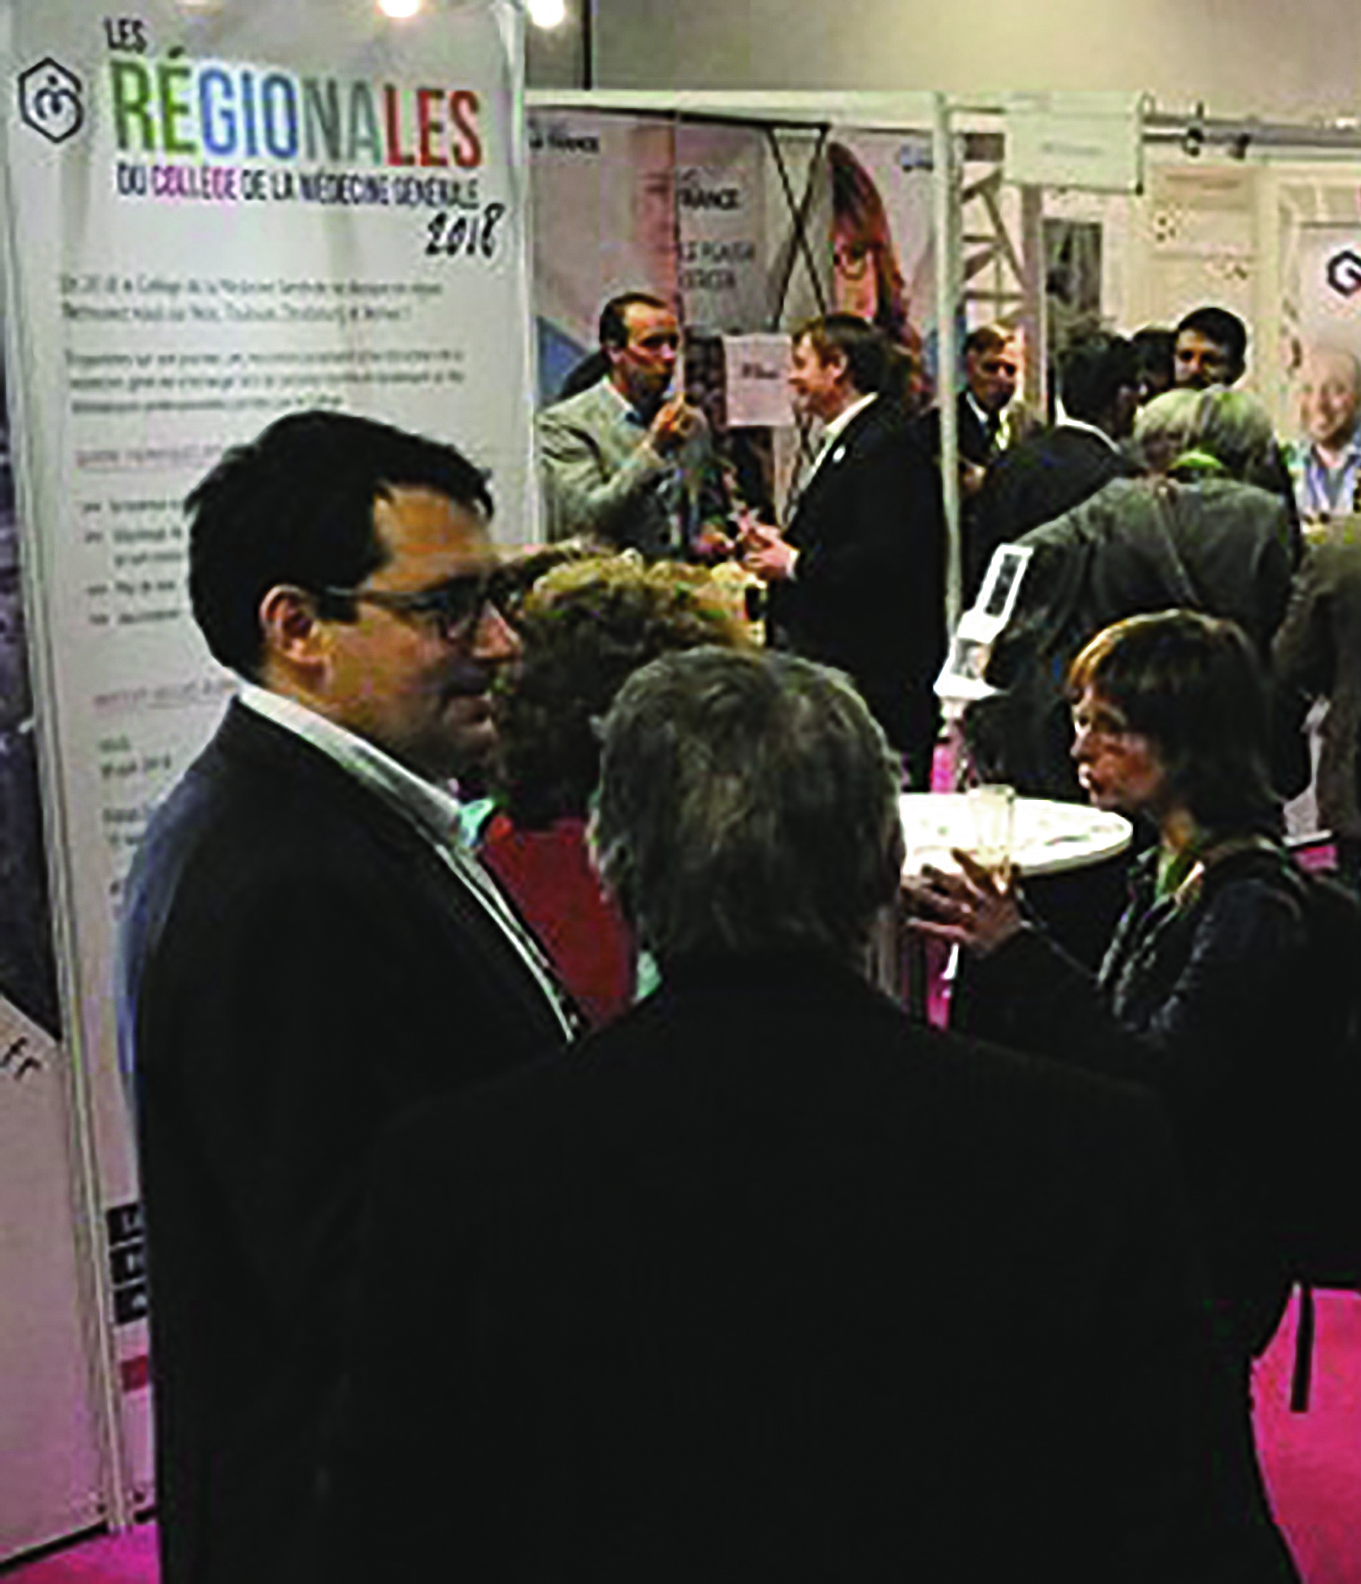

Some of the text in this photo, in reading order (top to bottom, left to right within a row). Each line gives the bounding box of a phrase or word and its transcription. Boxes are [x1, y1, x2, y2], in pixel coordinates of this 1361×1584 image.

[103, 17, 147, 54] LES
[110, 46, 482, 167] RÉGIONALES
[424, 203, 505, 258] 2018
